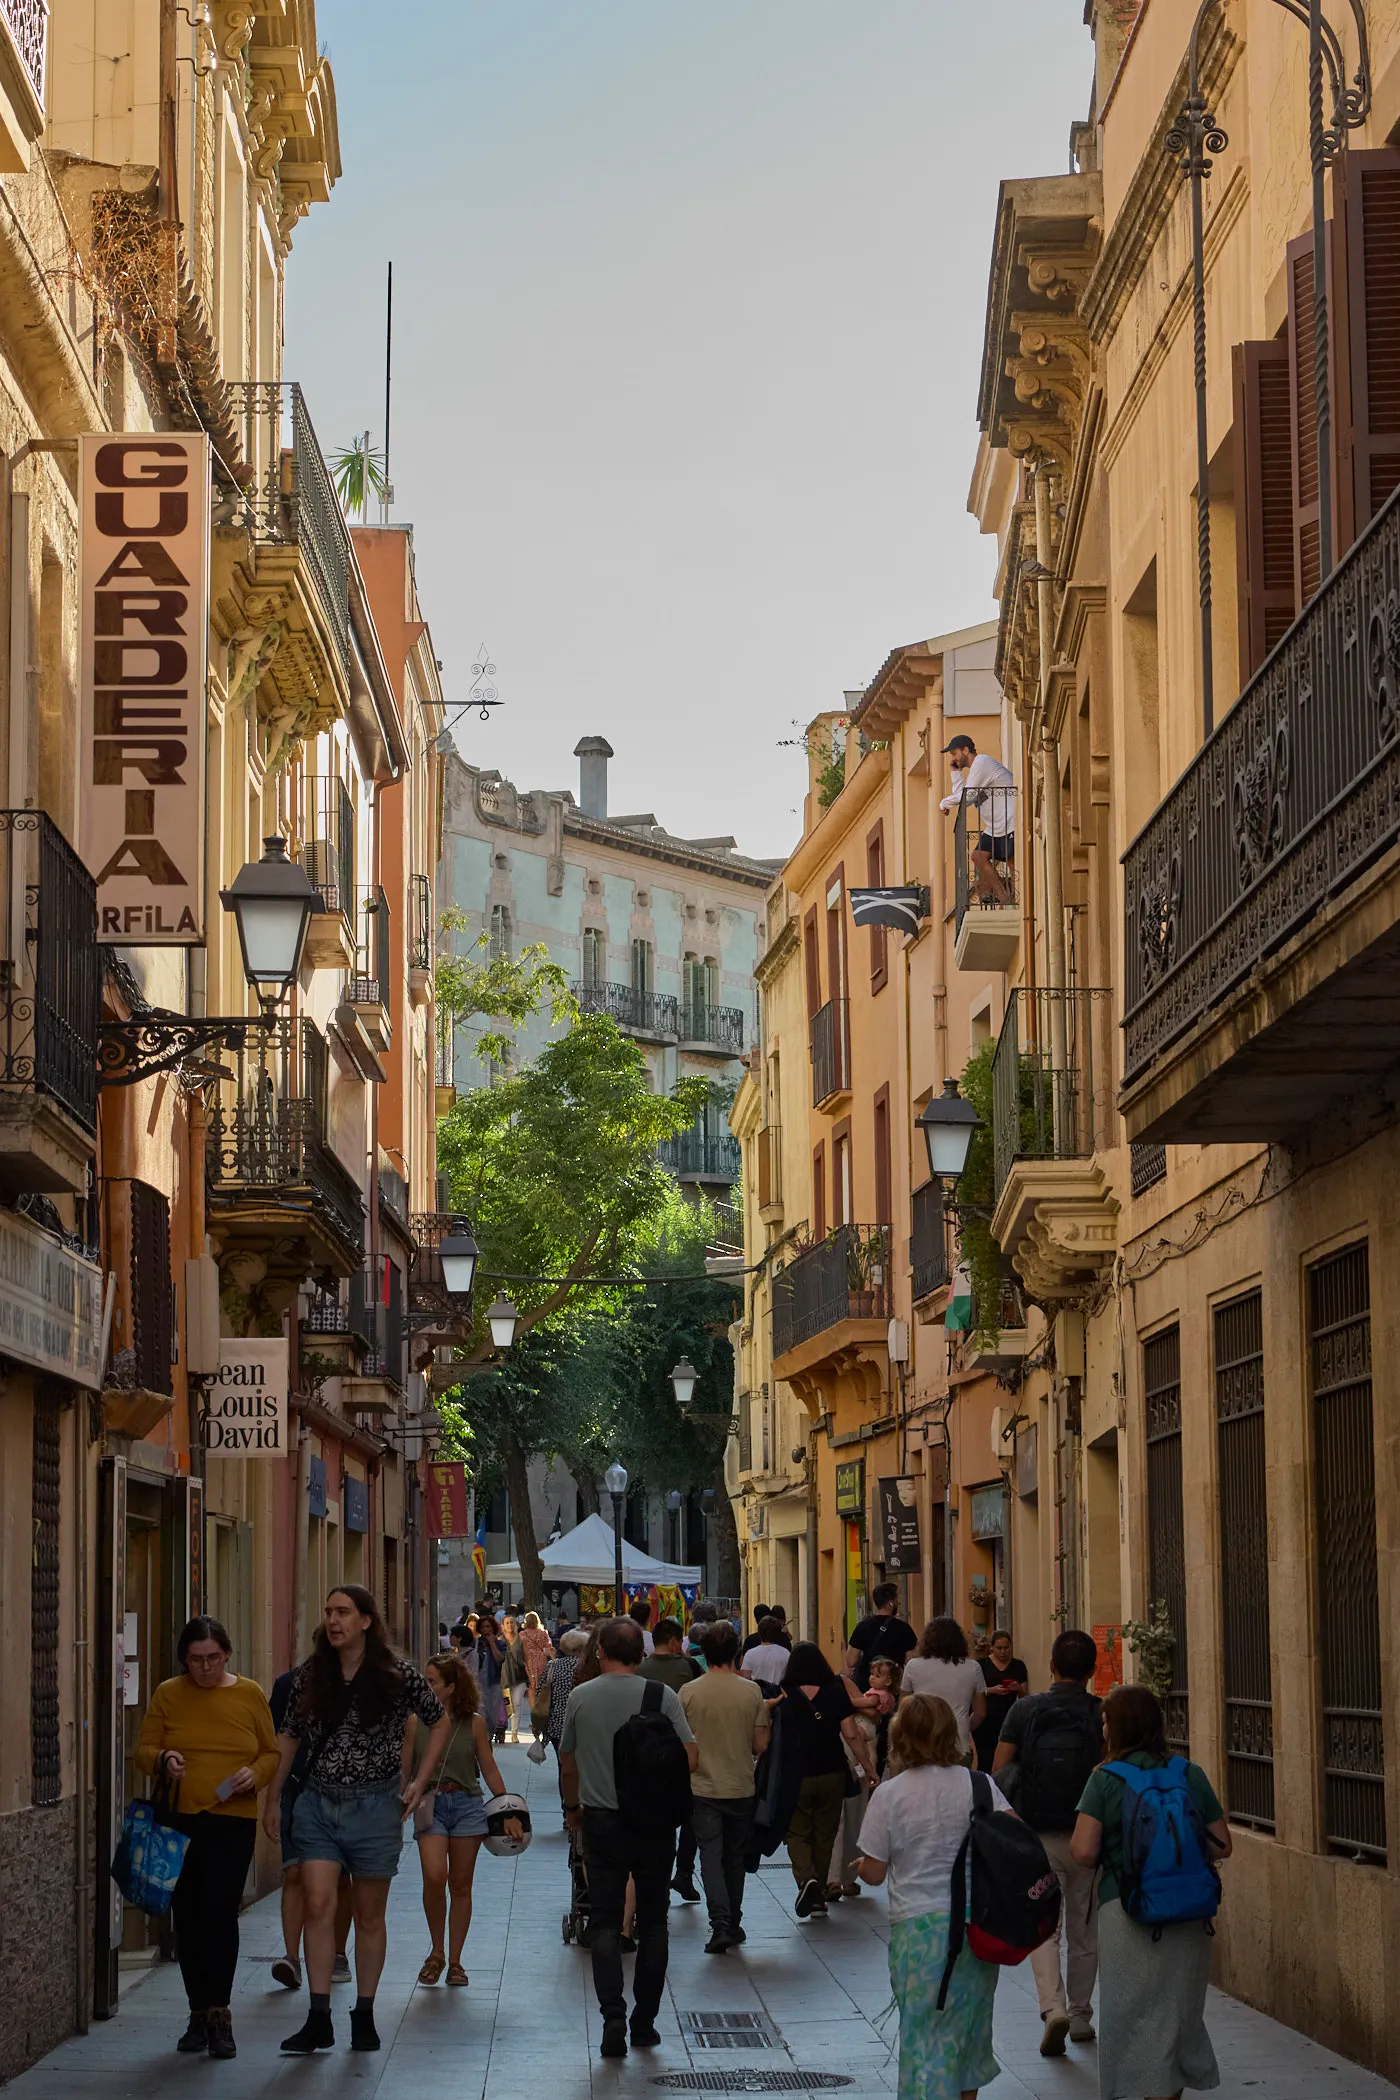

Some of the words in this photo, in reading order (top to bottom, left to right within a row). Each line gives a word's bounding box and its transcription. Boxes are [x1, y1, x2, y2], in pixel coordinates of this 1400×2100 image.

[93, 442, 190, 887] GUARDERIA
[97, 904, 196, 934] RFiLA
[57, 1261, 92, 1324] ORLA
[204, 1388, 278, 1418] Louis
[205, 1419, 281, 1449] David
[439, 1488, 453, 1536] TABACS
